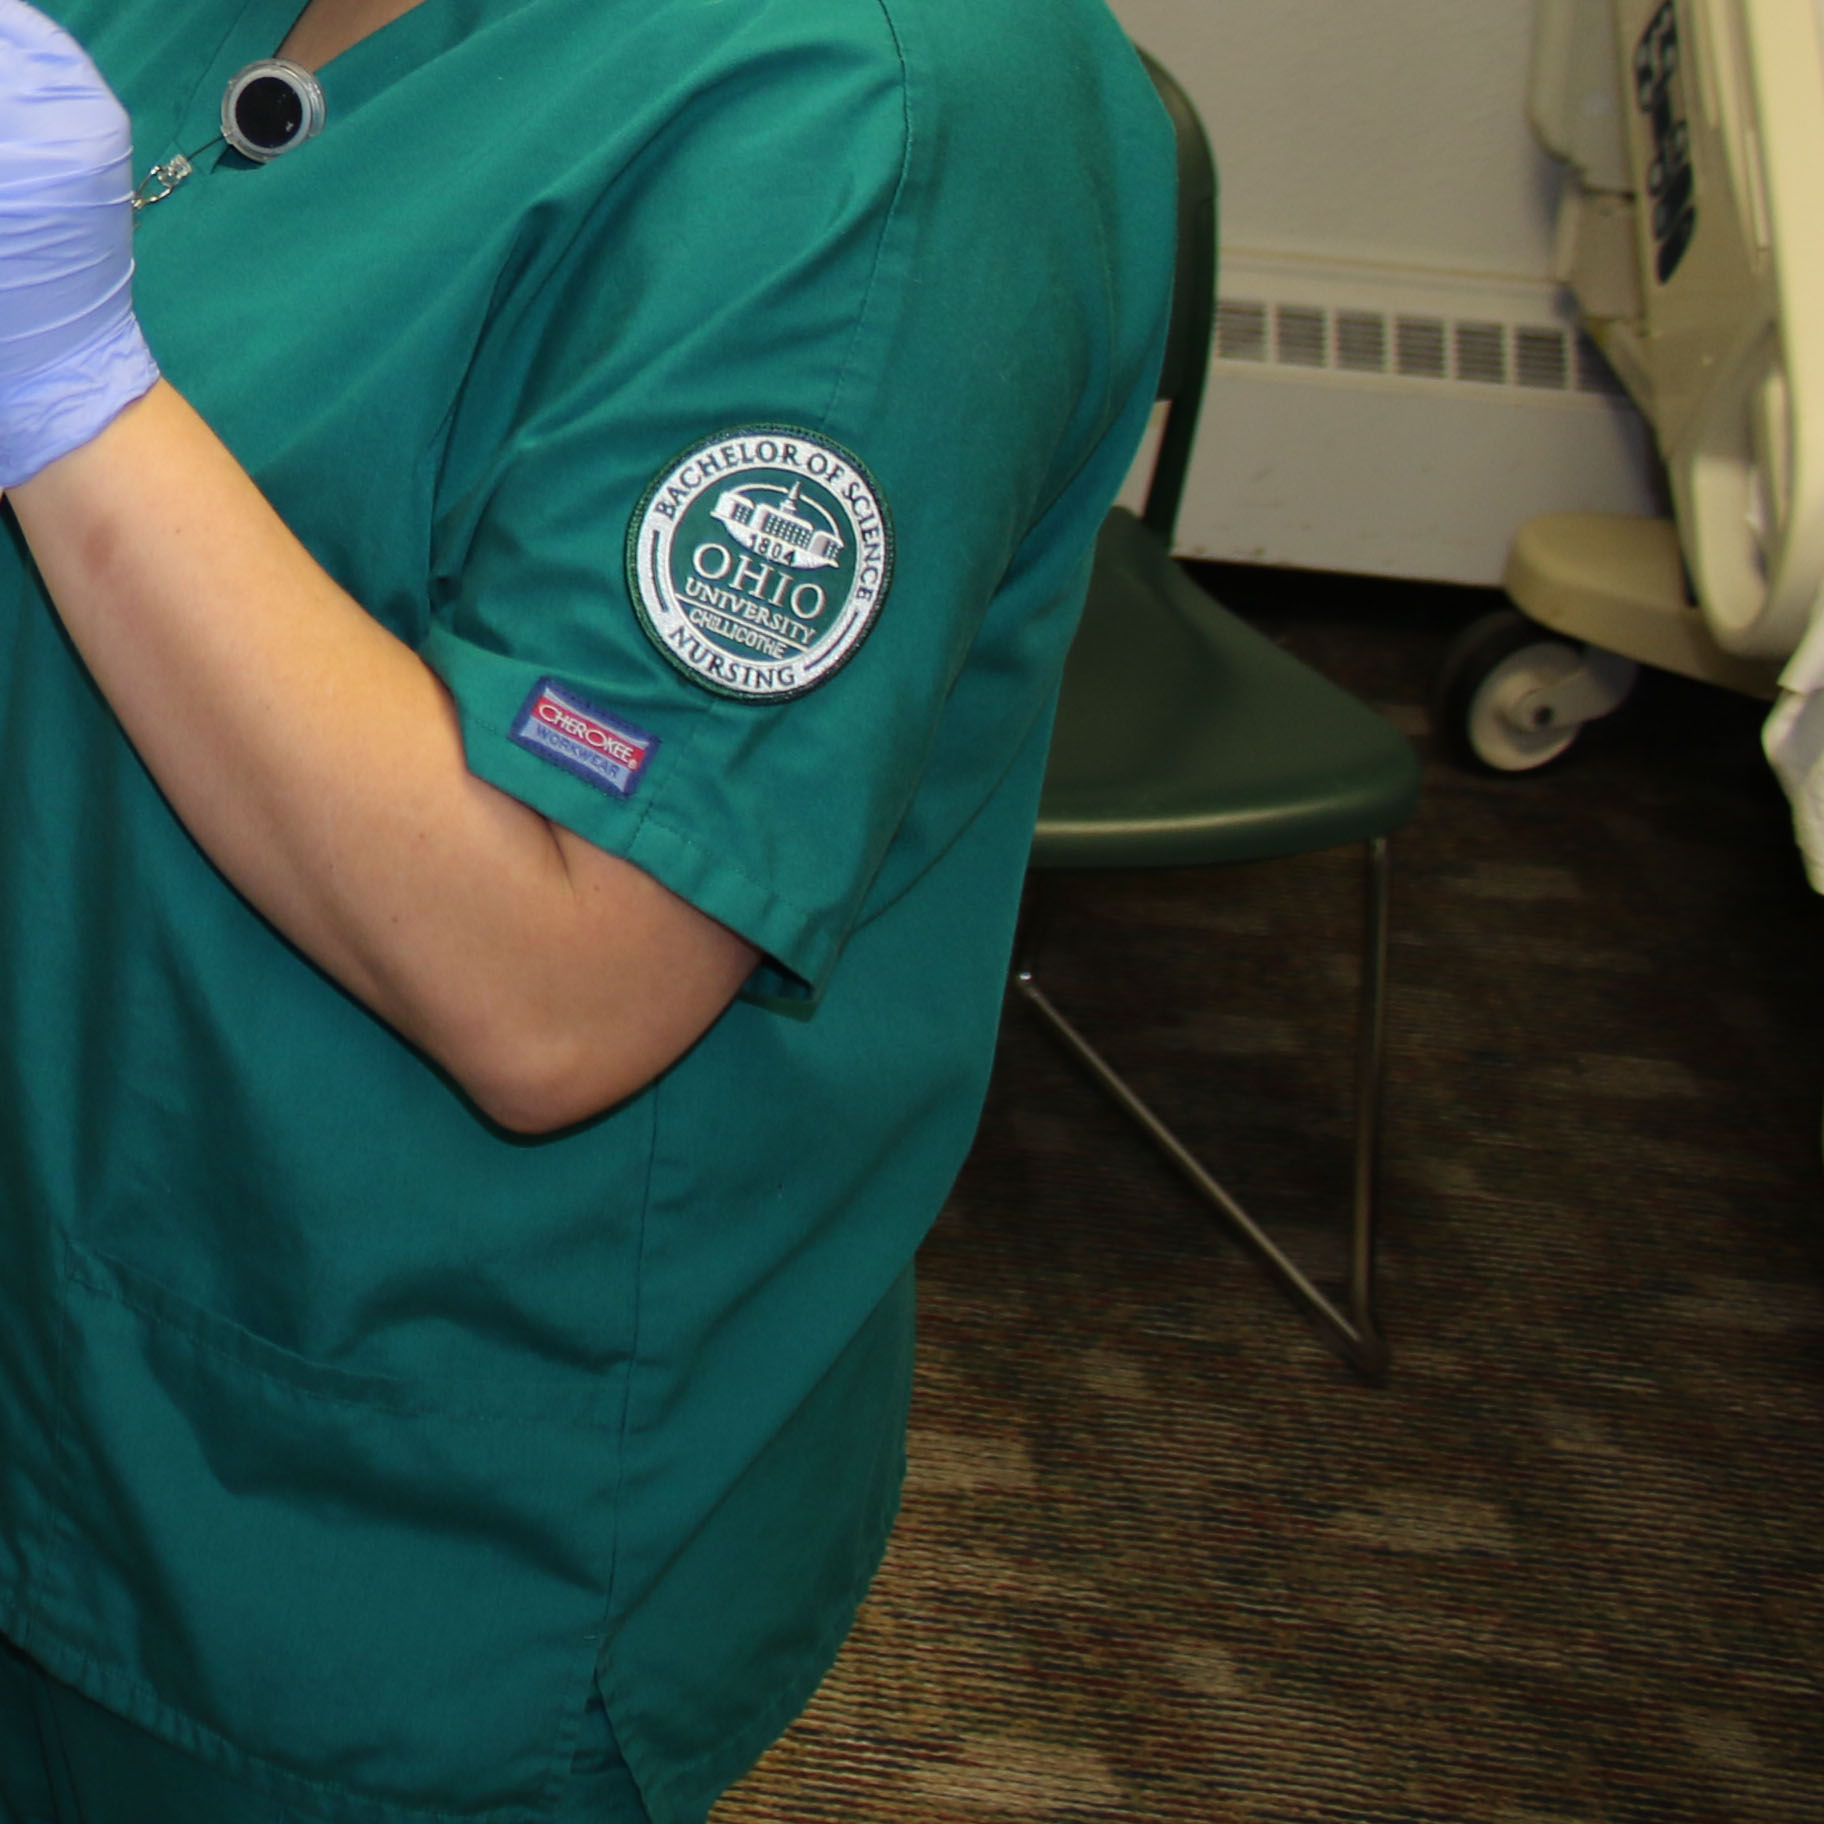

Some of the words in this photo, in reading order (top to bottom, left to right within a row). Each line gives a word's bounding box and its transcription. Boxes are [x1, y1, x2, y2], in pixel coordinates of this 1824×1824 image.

[654, 440, 801, 520] BACHELOR
[807, 453, 846, 482] OF
[842, 481, 881, 602] SCIENCE
[684, 576, 818, 645] UNIVERSITY
[692, 543, 827, 620] OHIO
[668, 625, 796, 689] NURSING
[689, 608, 788, 660] CHILLICOTHE
[535, 722, 621, 778] WORKWEAR
